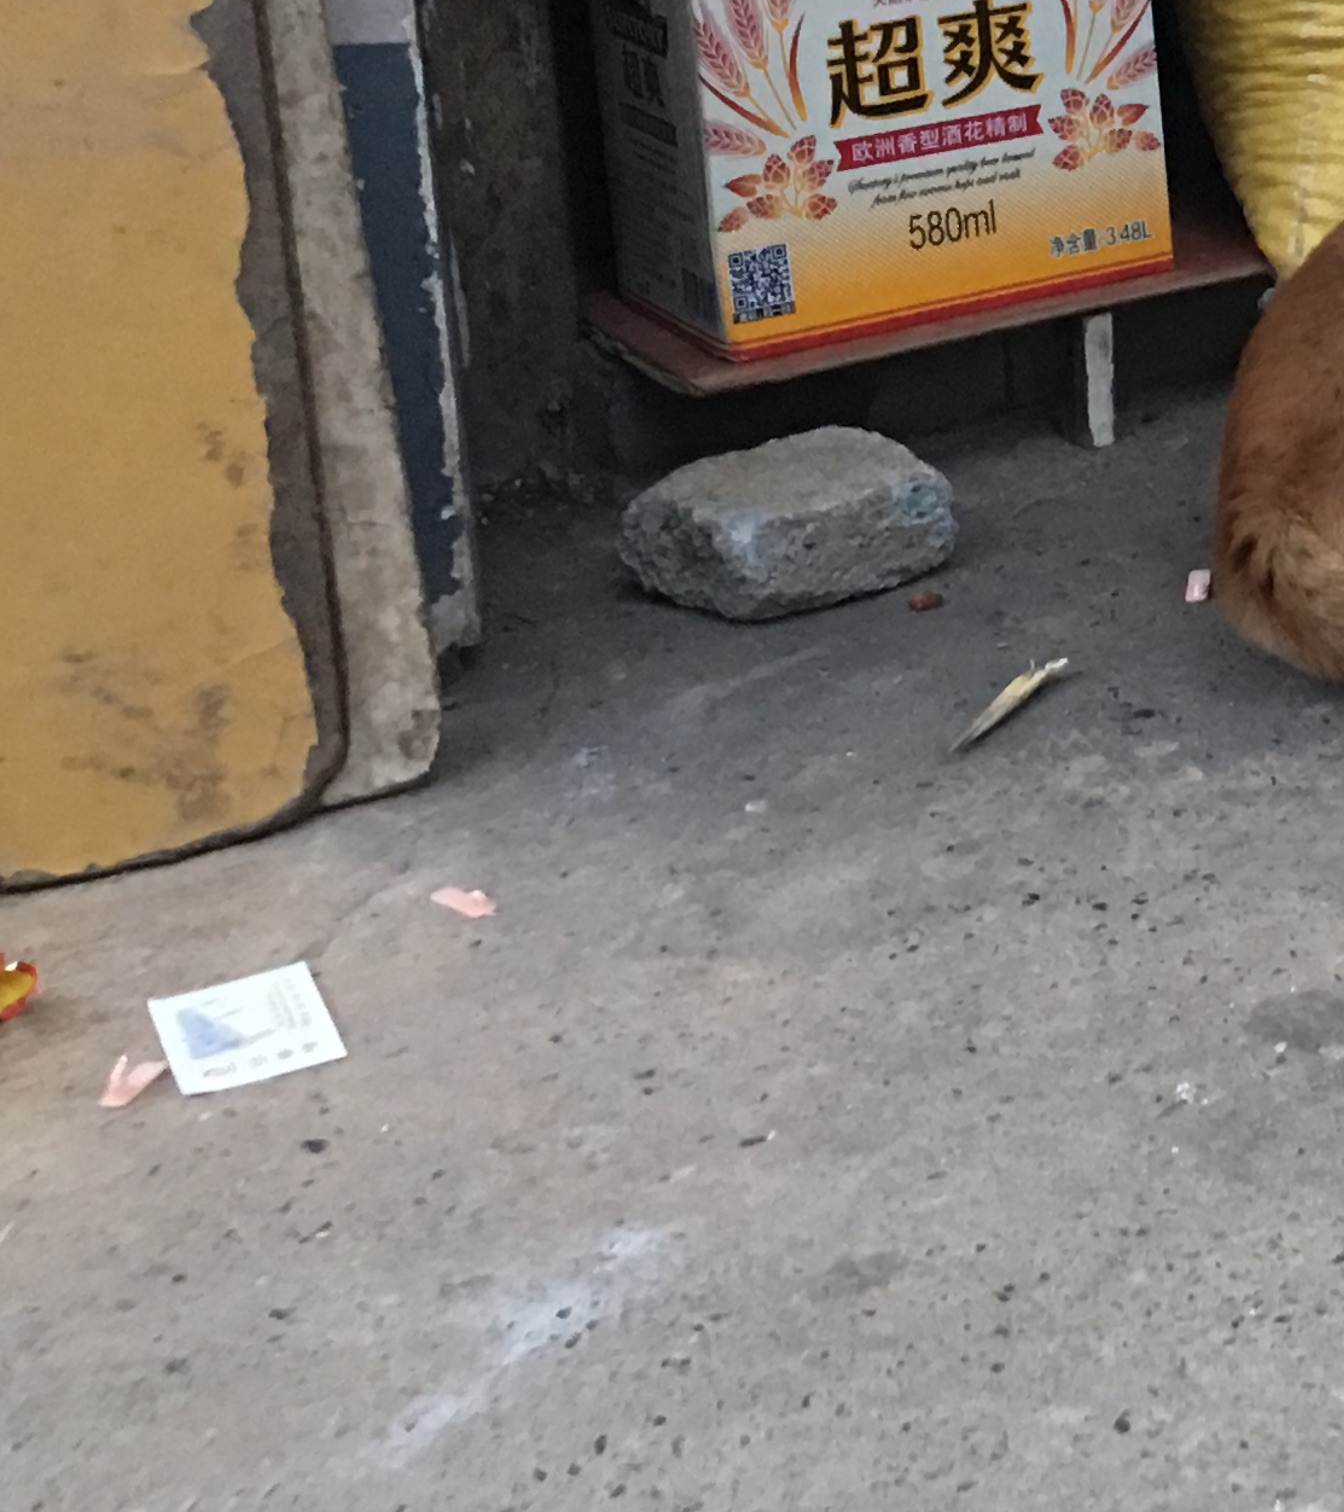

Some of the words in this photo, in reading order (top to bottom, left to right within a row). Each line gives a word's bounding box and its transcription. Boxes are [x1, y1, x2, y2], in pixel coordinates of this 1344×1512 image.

[851, 113, 1028, 163] 欧洲香型酒花精制
[908, 199, 998, 251] 580ml
[1050, 228, 1098, 258] 净含量
